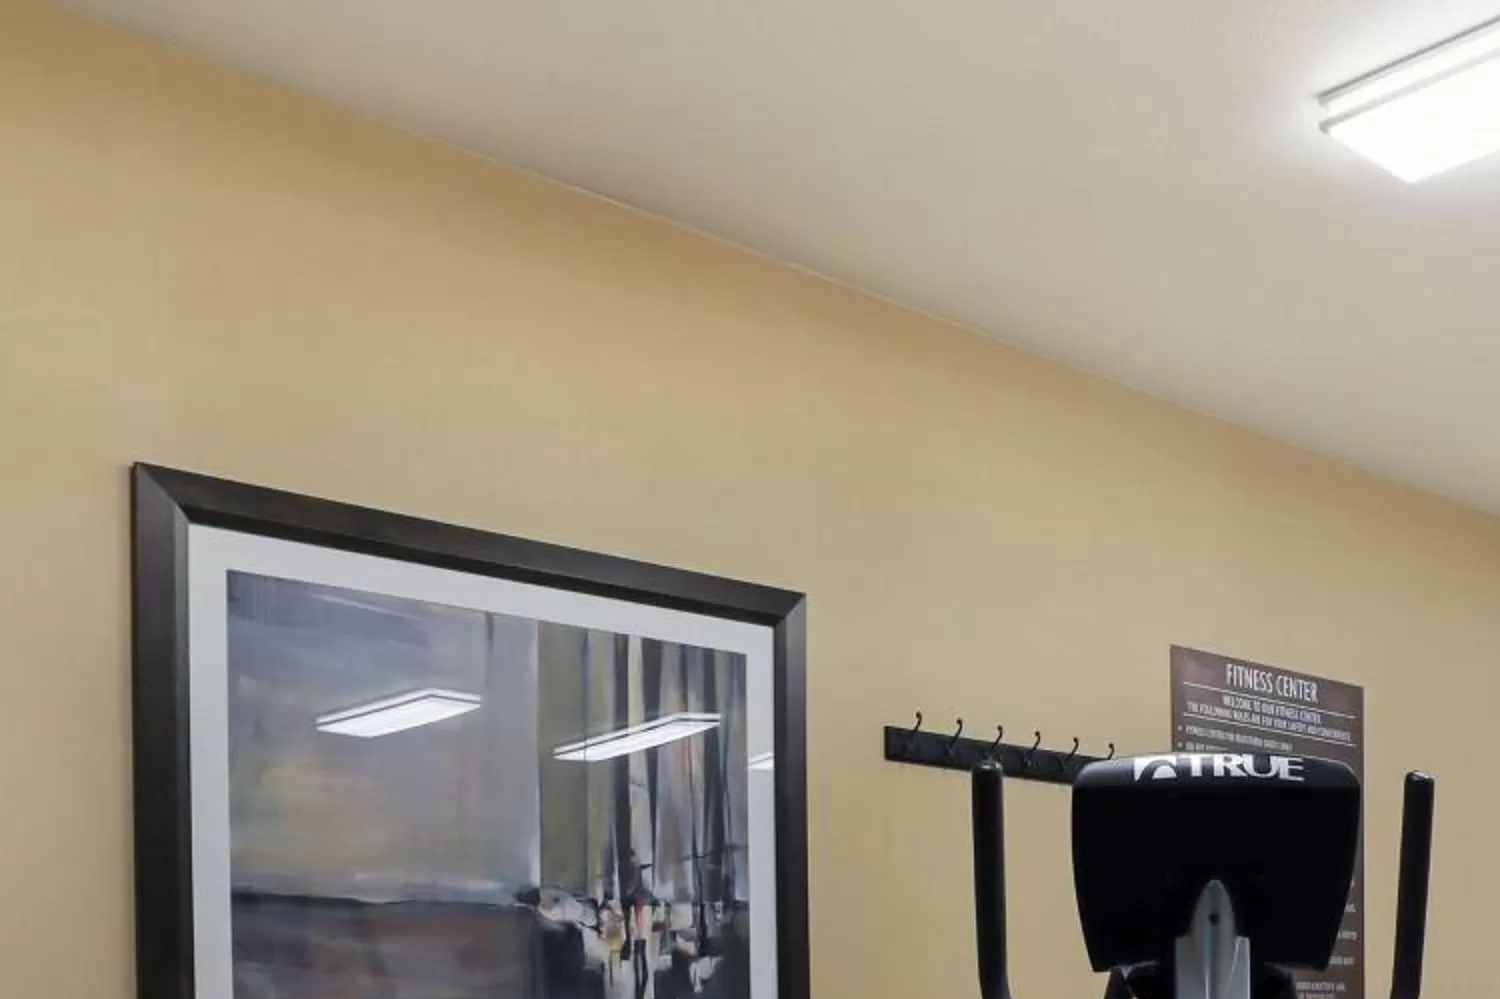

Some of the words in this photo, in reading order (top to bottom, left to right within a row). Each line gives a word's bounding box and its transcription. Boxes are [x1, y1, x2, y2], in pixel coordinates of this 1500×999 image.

[1225, 663, 1273, 696] FITNESS
[1275, 674, 1319, 703] CENTER
[1186, 753, 1305, 782] TRUE
